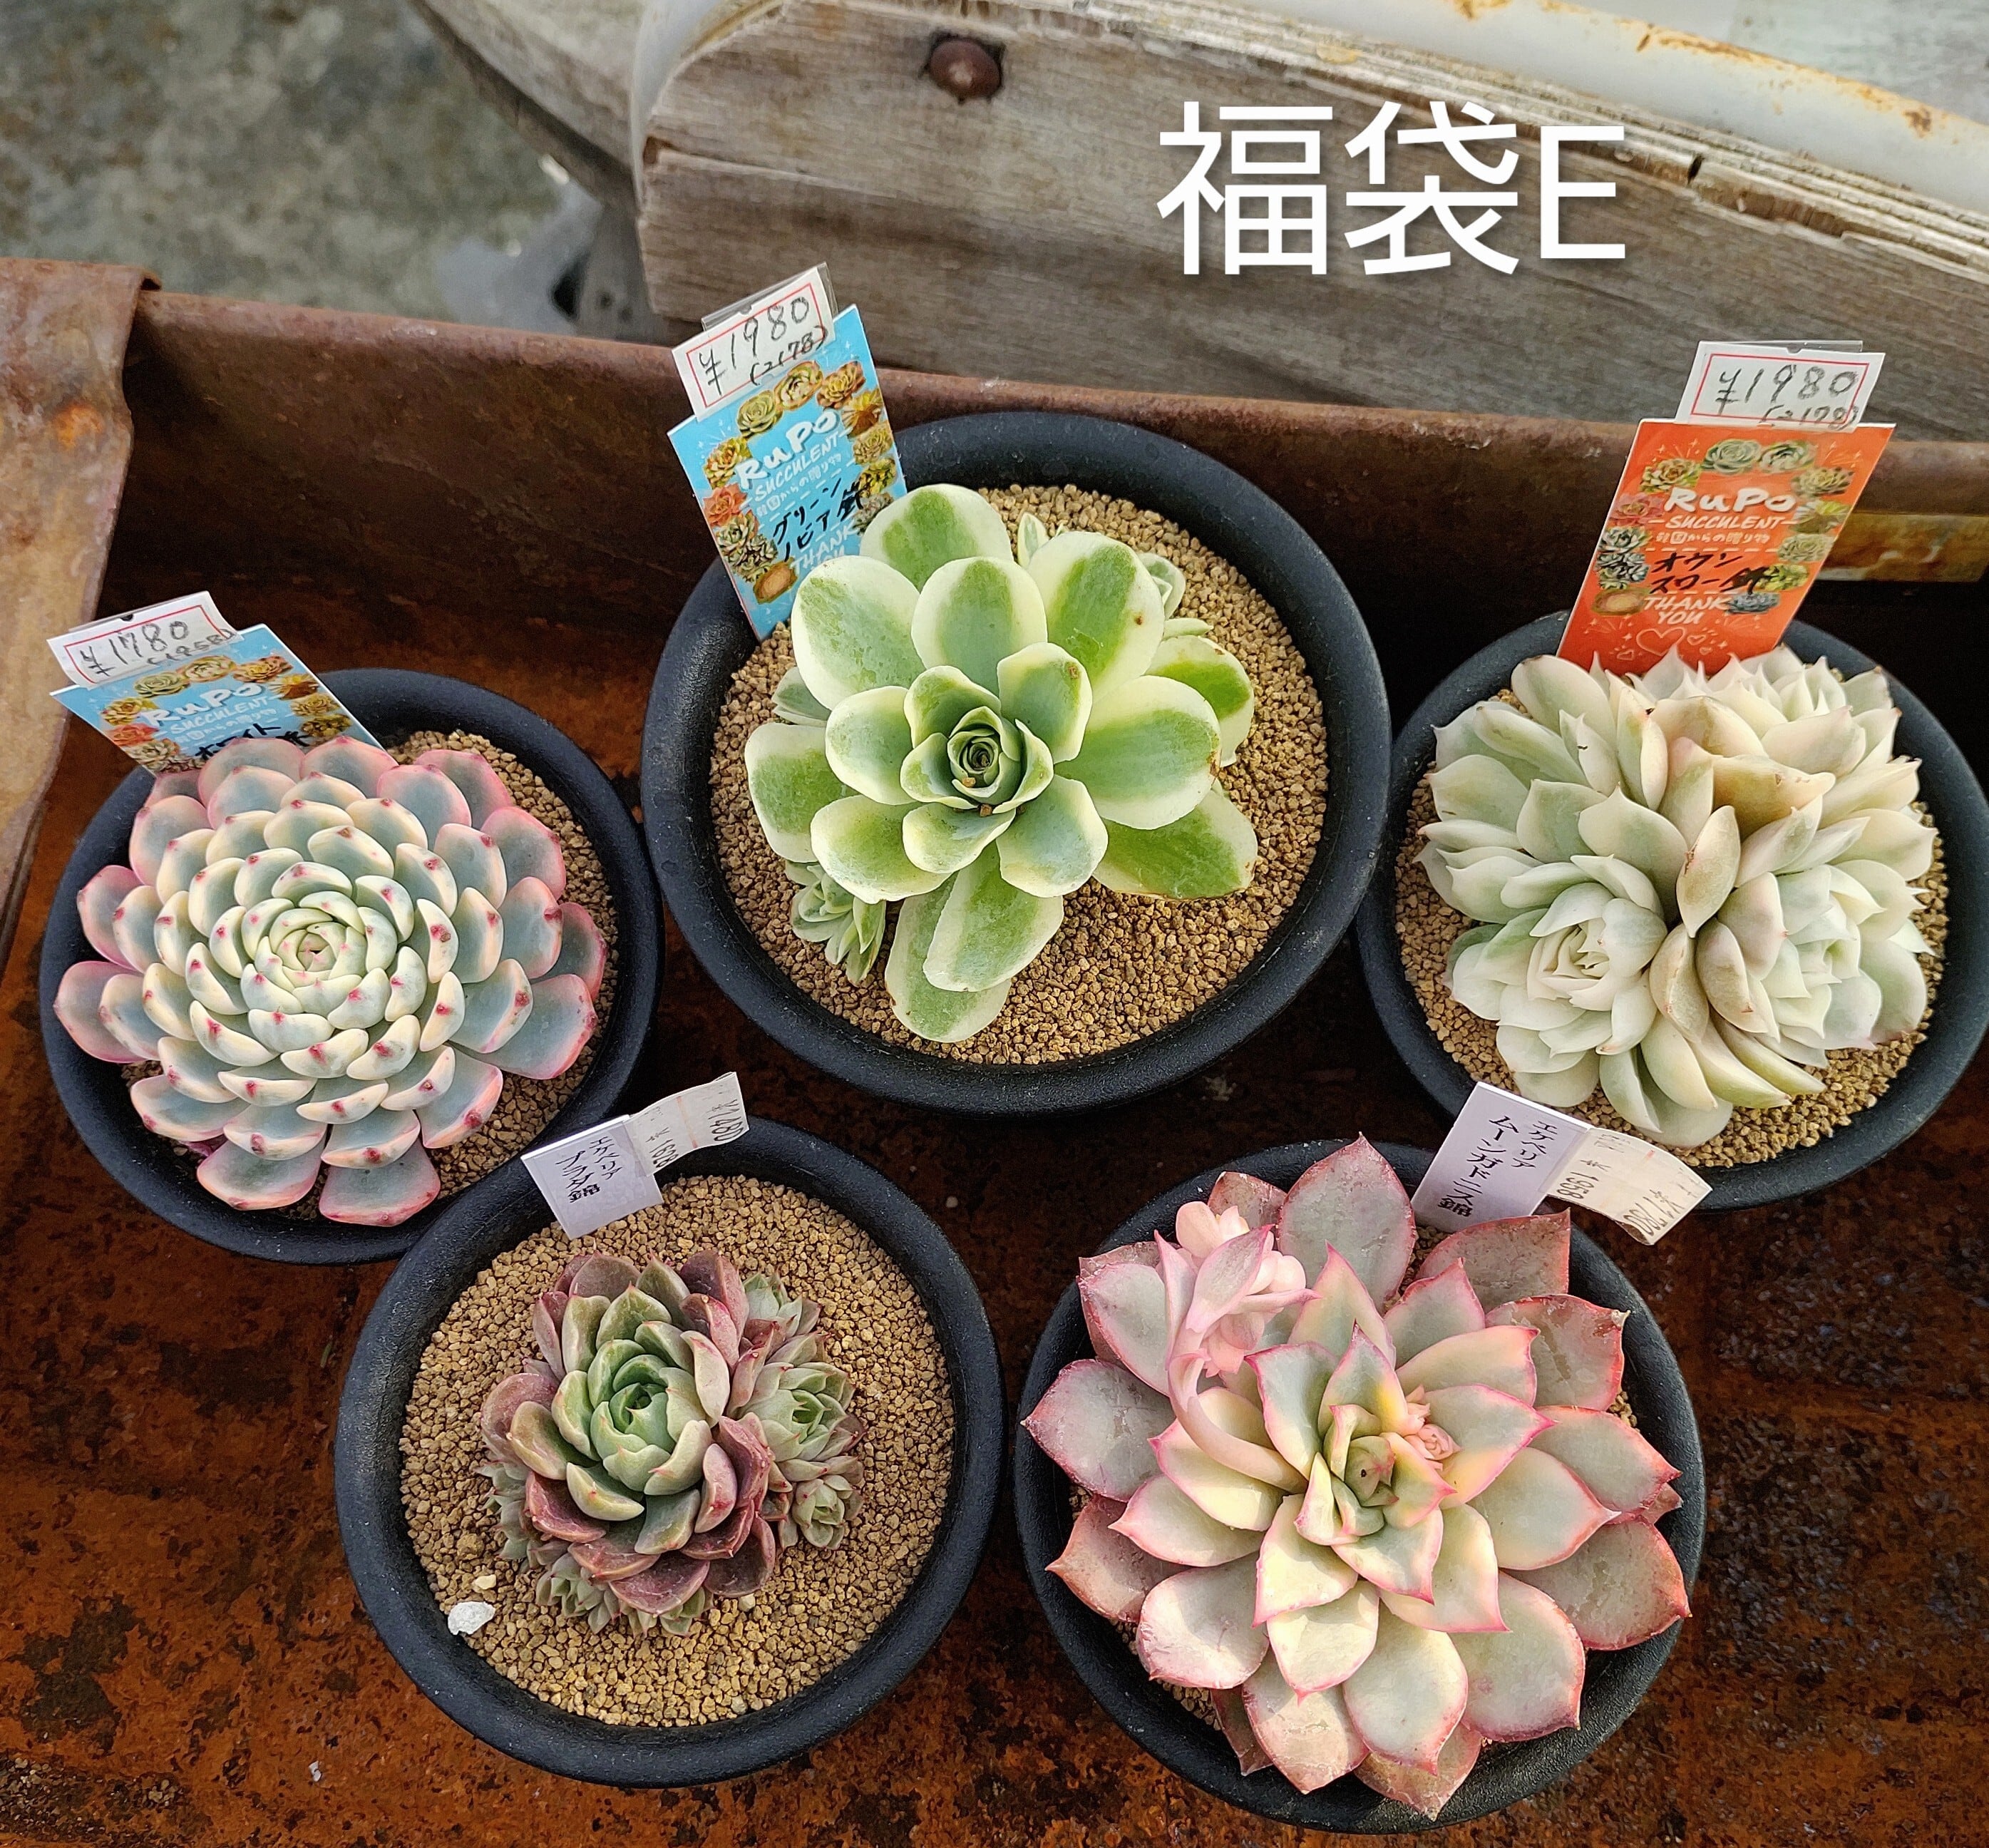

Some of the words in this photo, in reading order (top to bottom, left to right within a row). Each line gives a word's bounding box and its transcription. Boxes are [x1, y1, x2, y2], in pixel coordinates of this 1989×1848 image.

[699, 297, 810, 396] ¥1980
[1715, 364, 1859, 416] ¥1980
[754, 431, 839, 502] SUCCULENT
[791, 520, 859, 575] THANK
[1665, 515, 1784, 529] SUCCULENT
[1644, 596, 1732, 610] THANK
[1657, 611, 1705, 625] YOU
[80, 621, 190, 677] ¥1780
[589, 1136, 622, 1180] エケベリア
[1437, 1115, 1519, 1217] ムーンガドニス錦
[1511, 1121, 1558, 1168] エケベリア
